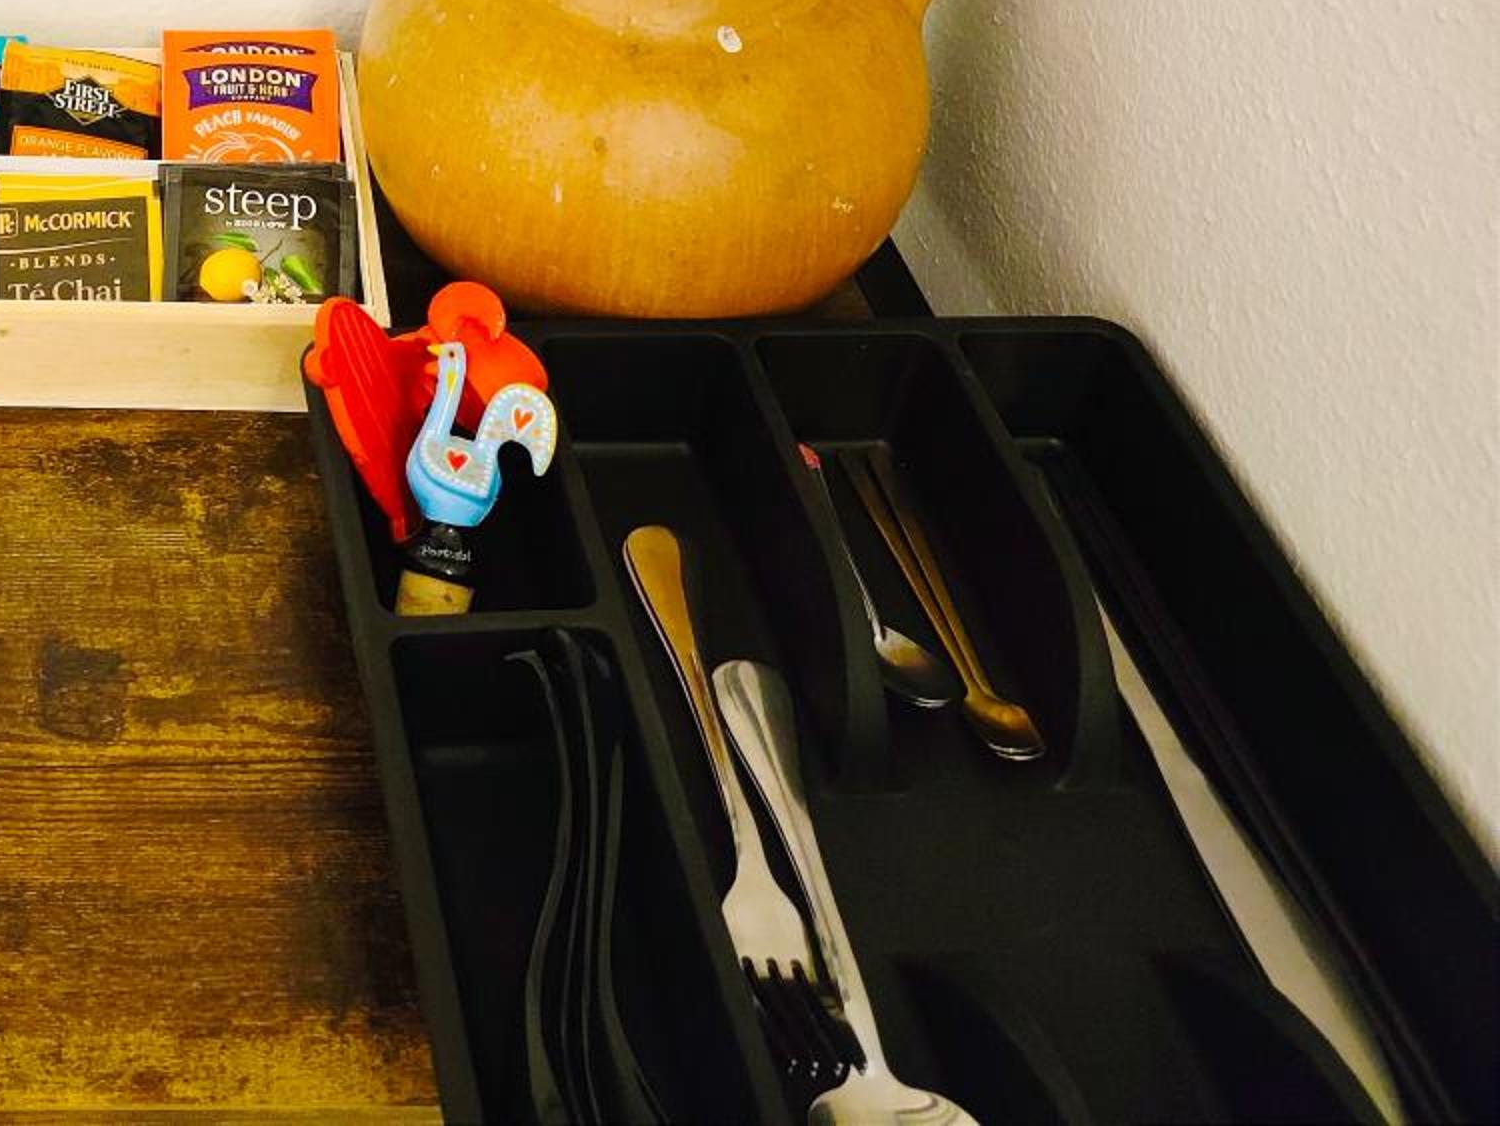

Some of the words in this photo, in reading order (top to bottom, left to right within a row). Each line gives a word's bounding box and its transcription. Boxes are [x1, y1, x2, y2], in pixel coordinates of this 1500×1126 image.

[201, 68, 301, 88] LONDON
[213, 84, 244, 96] FRUIT
[63, 79, 113, 104] FIRST
[54, 94, 119, 119] STREET
[194, 109, 243, 138] PEACH
[204, 182, 317, 231] steep
[24, 210, 133, 232] McCORMICK
[19, 253, 106, 269] BLENDS
[7, 282, 46, 301] Té
[51, 278, 122, 302] Chai
